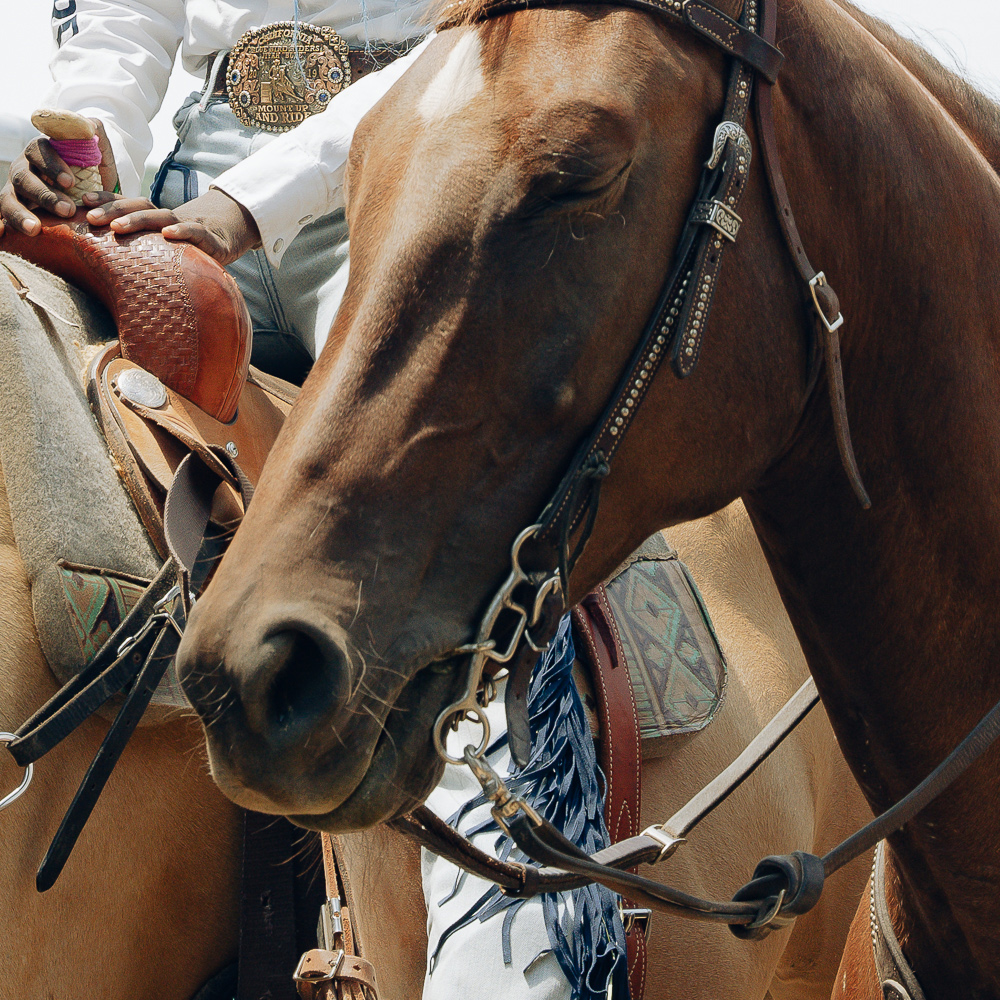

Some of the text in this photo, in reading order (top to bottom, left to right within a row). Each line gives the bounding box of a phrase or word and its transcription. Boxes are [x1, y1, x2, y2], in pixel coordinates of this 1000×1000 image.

[258, 29, 312, 45] CALIFORNIA
[289, 44, 321, 53] RDERS
[308, 68, 318, 79] 19
[258, 104, 309, 112] MOUNT UP
[255, 111, 312, 124] AND RIDE
